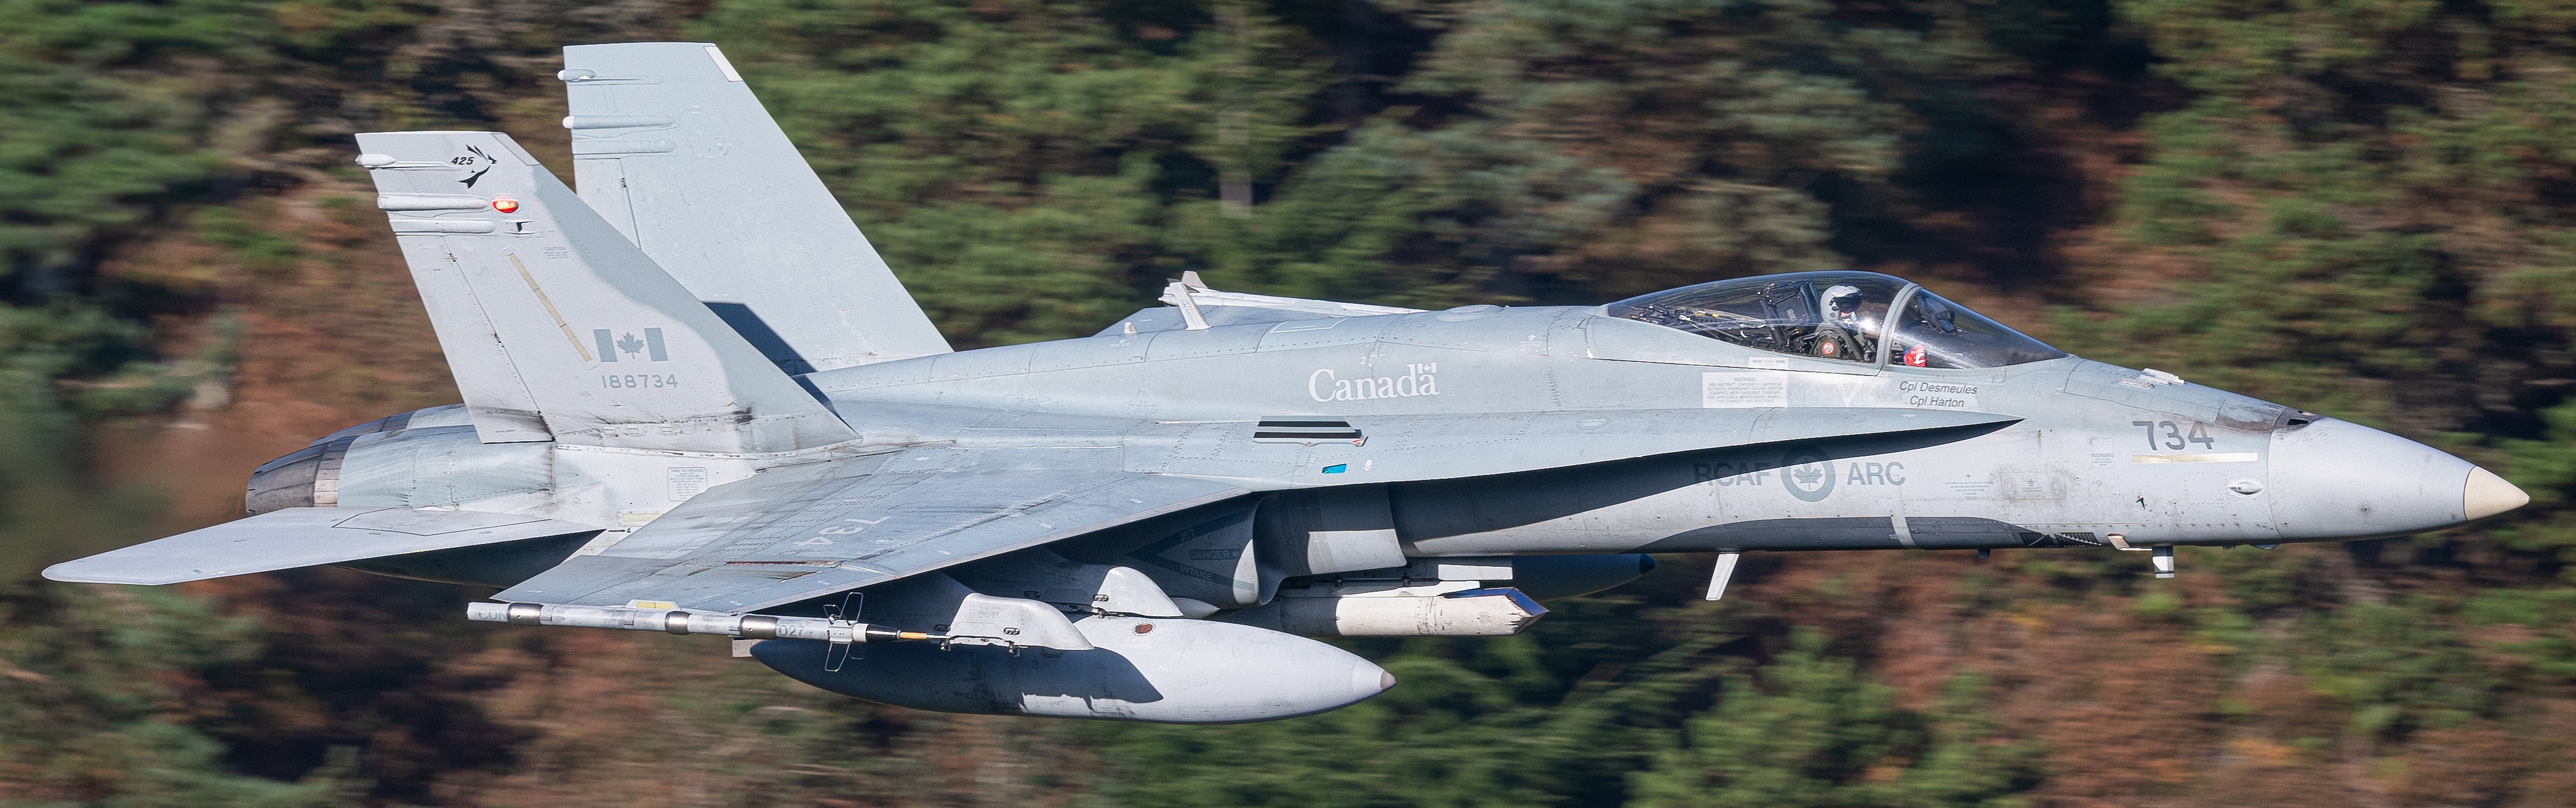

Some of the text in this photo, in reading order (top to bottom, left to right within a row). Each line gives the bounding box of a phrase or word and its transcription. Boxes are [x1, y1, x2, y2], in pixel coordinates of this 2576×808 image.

[451, 156, 475, 165] 425
[602, 374, 678, 389] 188734
[1308, 363, 1440, 403] Canada
[1900, 381, 1978, 394] Cpl Desmeules
[1910, 395, 1964, 407] Cpl Harton
[2132, 421, 2215, 450] 734
[1693, 461, 1906, 486] RCAF ARC
[1191, 550, 1230, 559] DANGER
[779, 625, 804, 636] 027
